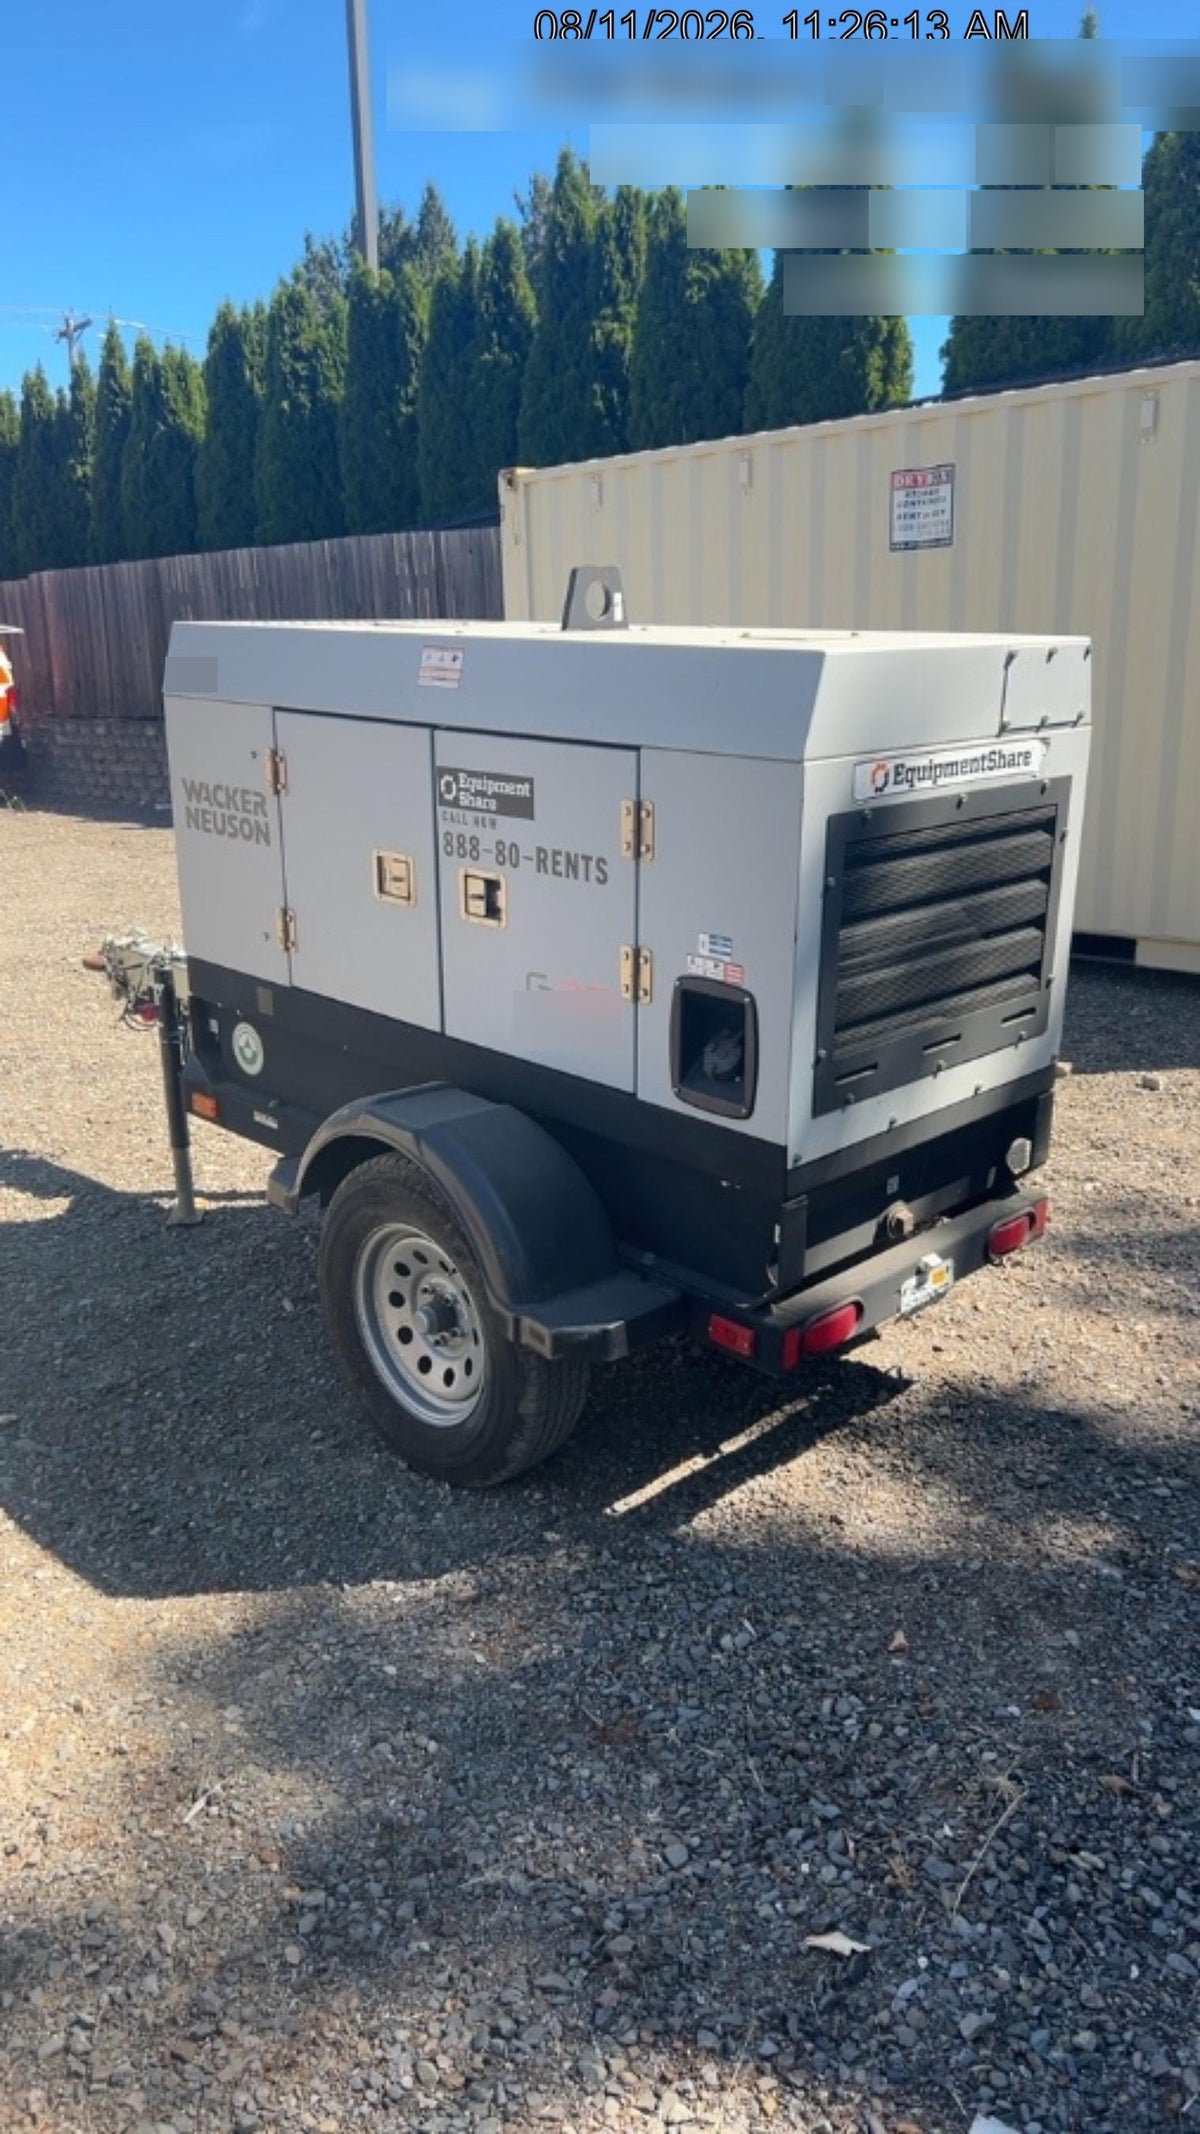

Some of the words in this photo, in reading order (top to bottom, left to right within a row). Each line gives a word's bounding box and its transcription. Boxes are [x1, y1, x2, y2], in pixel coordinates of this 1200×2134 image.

[458, 772, 531, 797] Equipment
[893, 750, 1032, 787] EquipmentShare
[182, 778, 269, 818] WACKER
[459, 791, 497, 811] Share
[185, 805, 271, 847] NEUSON
[442, 810, 469, 826] CALL
[442, 831, 608, 885] 888-80-RENTS
